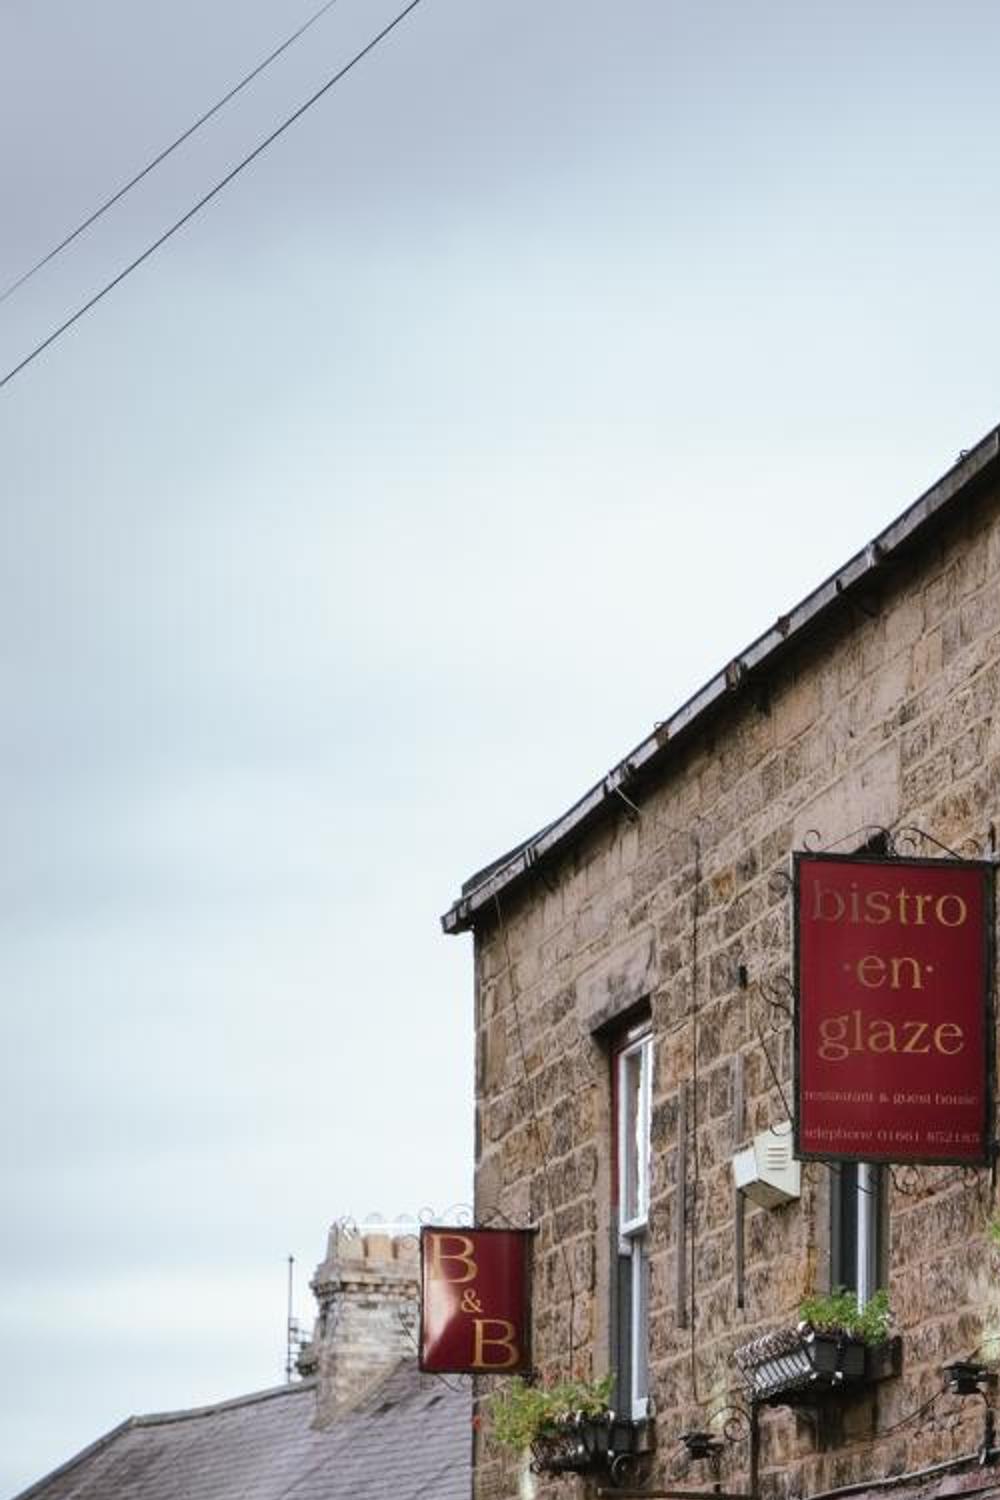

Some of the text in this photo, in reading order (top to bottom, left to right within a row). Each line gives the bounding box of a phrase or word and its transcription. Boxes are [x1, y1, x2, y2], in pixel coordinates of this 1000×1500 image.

[811, 879, 968, 928] bistro
[818, 1010, 965, 1062] glaze
[429, 1234, 478, 1283] B
[460, 1287, 484, 1313] &
[470, 1318, 521, 1368] B
